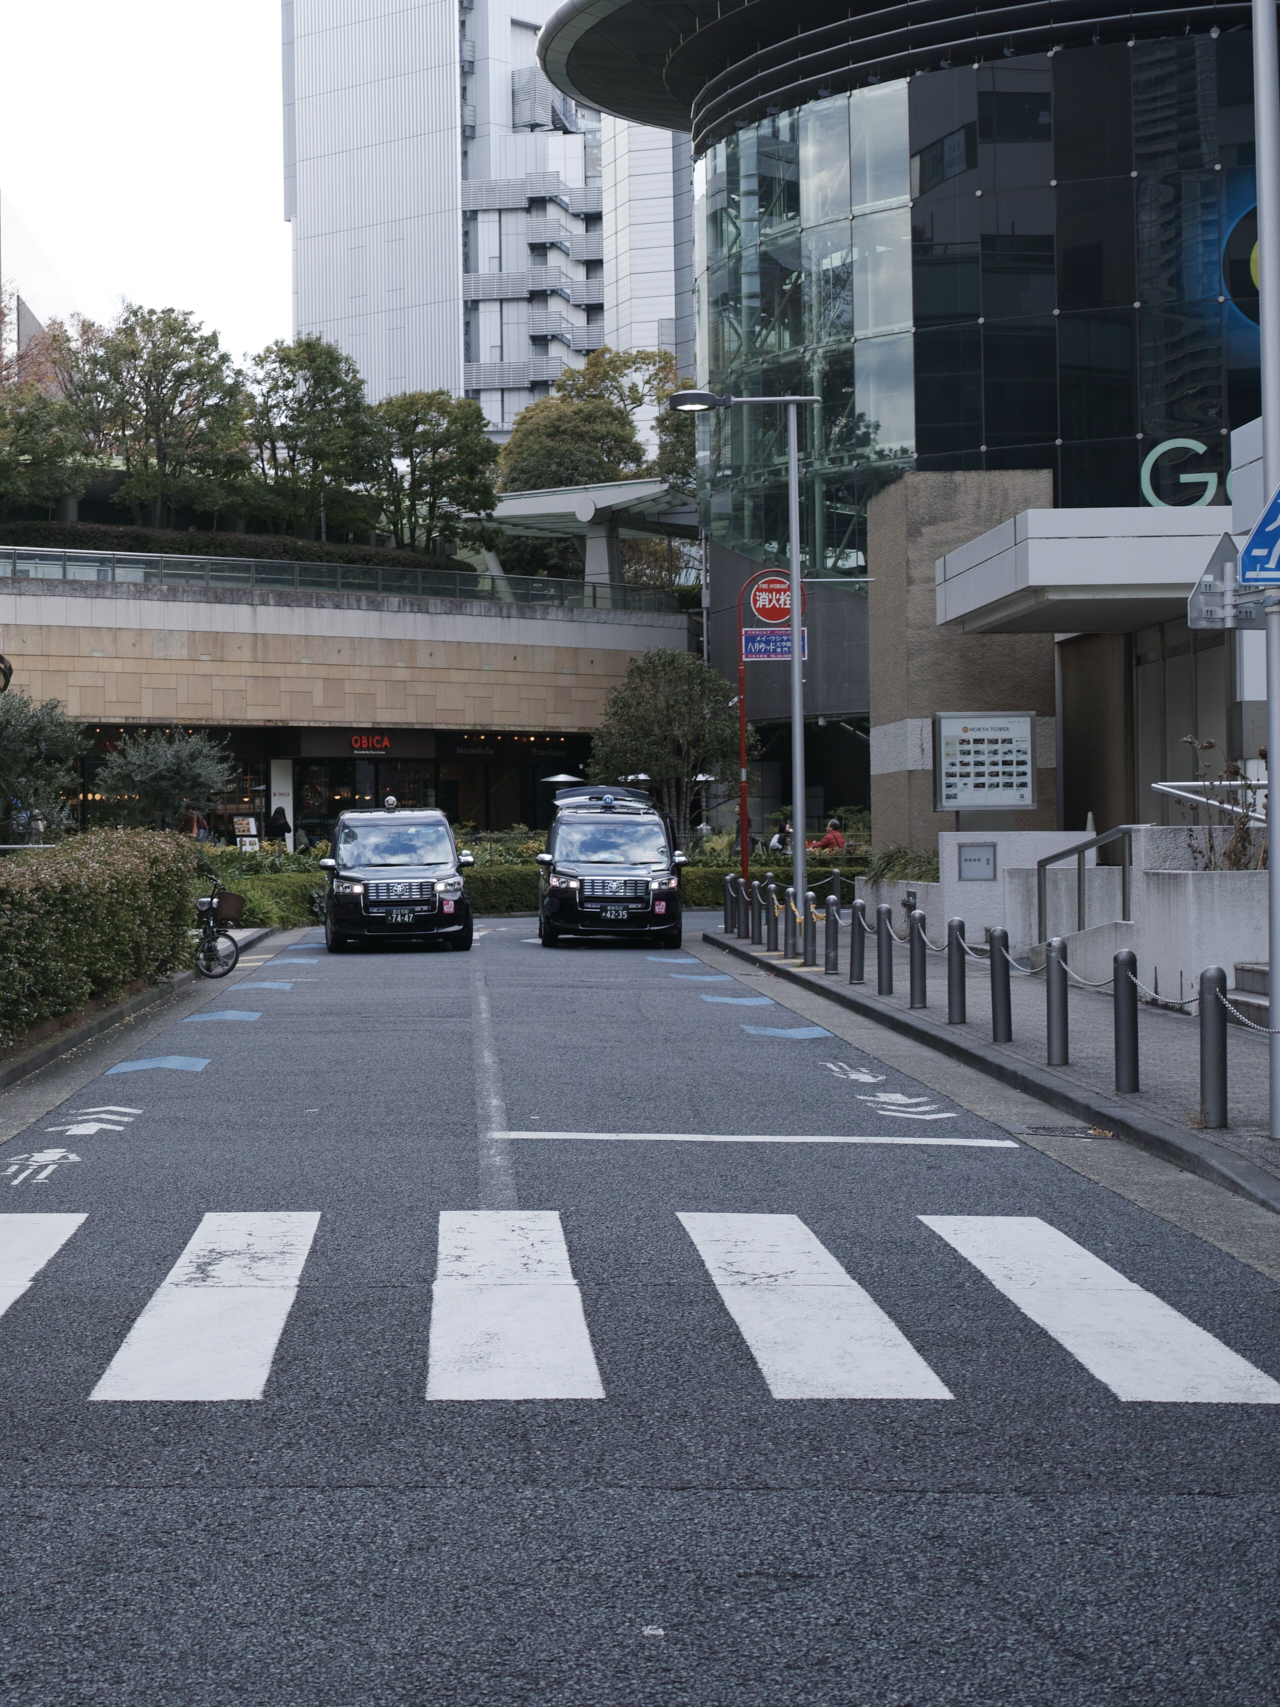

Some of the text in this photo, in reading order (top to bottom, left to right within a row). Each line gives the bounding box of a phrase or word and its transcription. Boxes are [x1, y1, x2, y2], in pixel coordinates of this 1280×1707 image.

[1141, 438, 1232, 507] G
[756, 591, 791, 608] 消火栓
